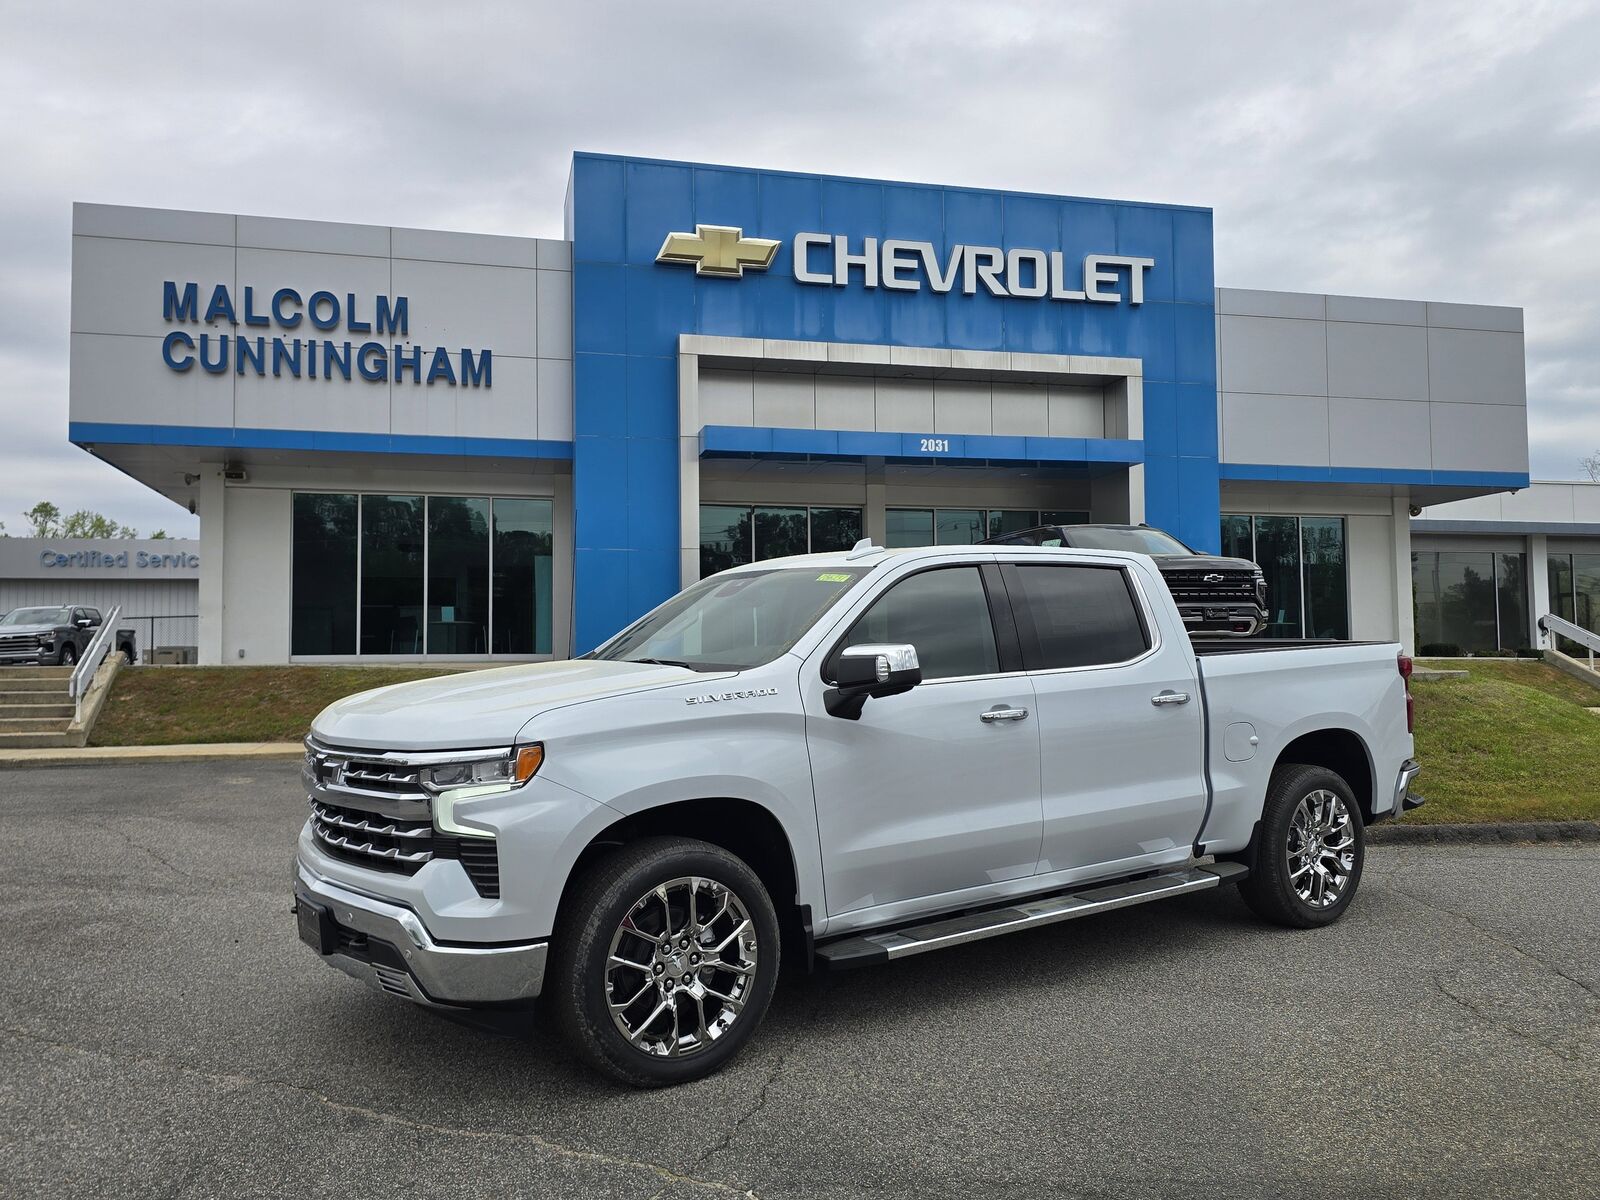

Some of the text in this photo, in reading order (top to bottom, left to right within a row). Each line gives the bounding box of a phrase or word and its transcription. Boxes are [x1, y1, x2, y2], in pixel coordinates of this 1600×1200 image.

[793, 232, 1155, 304] CHEVROLET
[163, 281, 408, 335] MALCOLM
[162, 331, 492, 387] CUNNINGHAM
[920, 438, 949, 452] 2031
[40, 550, 128, 568] Certified
[685, 688, 778, 705] SILVERADO
